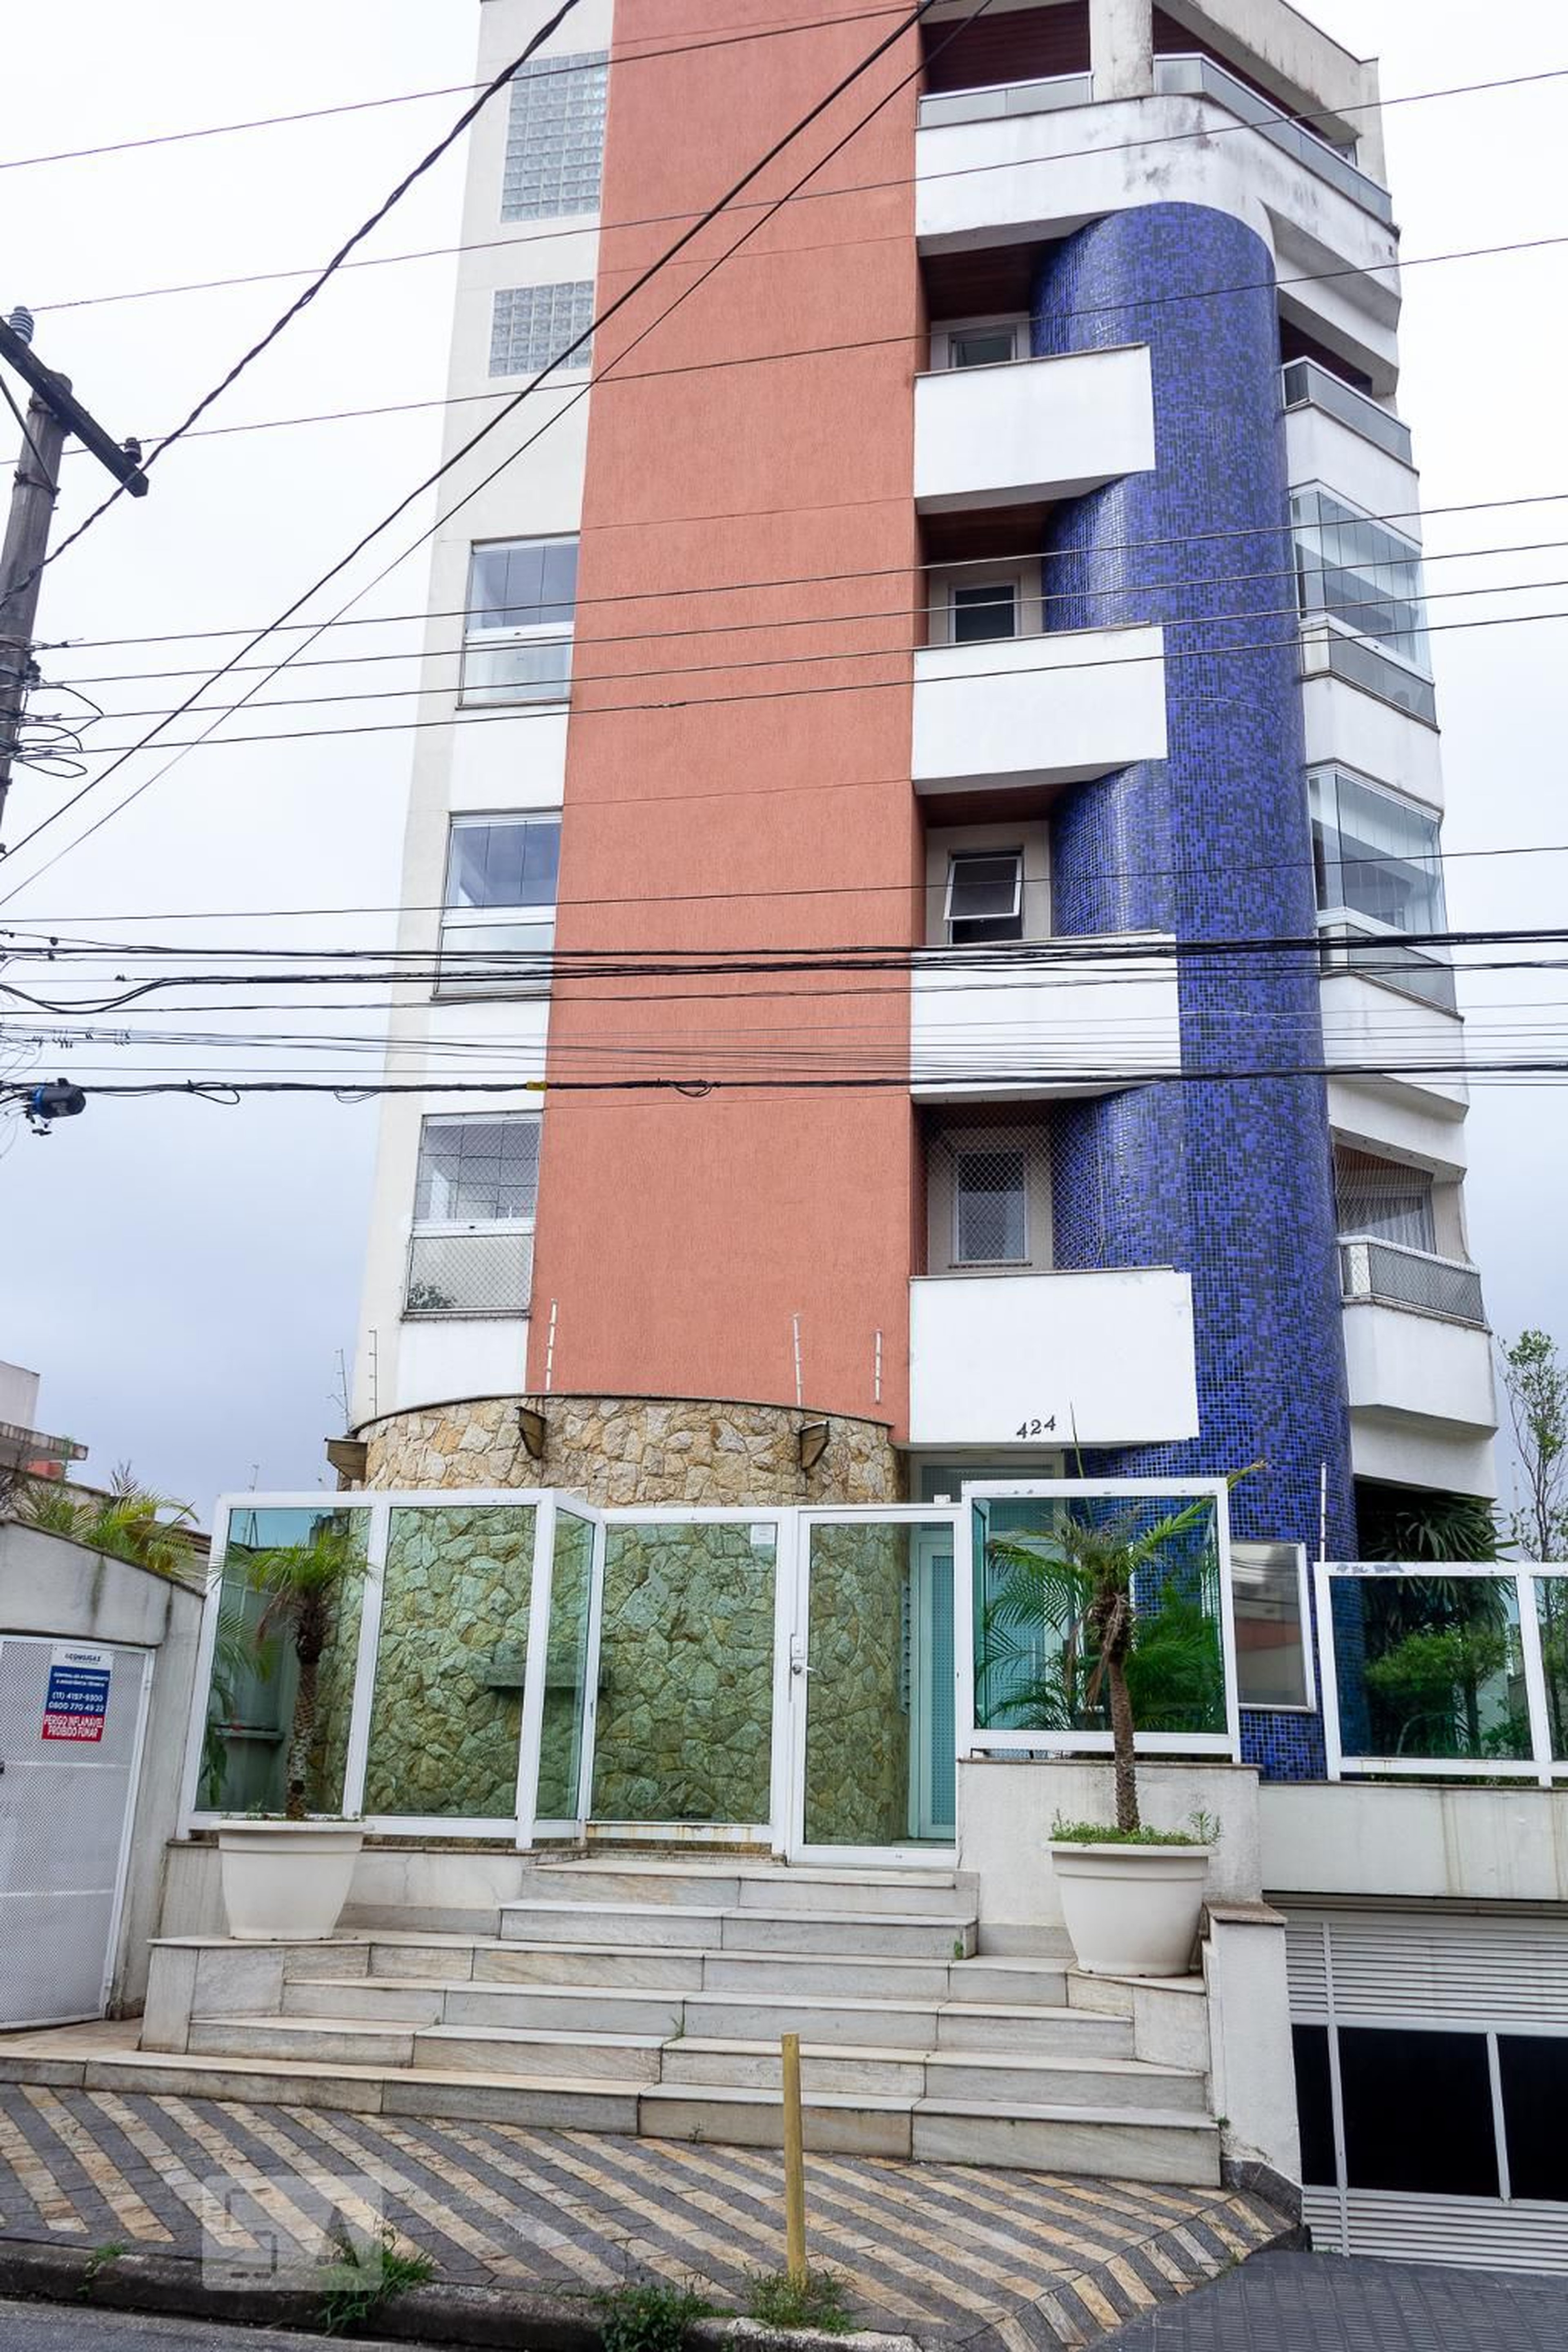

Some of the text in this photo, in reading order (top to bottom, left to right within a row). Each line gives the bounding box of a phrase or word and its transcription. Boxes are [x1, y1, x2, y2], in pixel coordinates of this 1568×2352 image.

[1016, 1415, 1056, 1439] 424
[49, 1701, 69, 1709] 0800
[44, 1715, 68, 1726] PERIGO
[47, 1725, 98, 1737] PROIBIDO FUMAR
